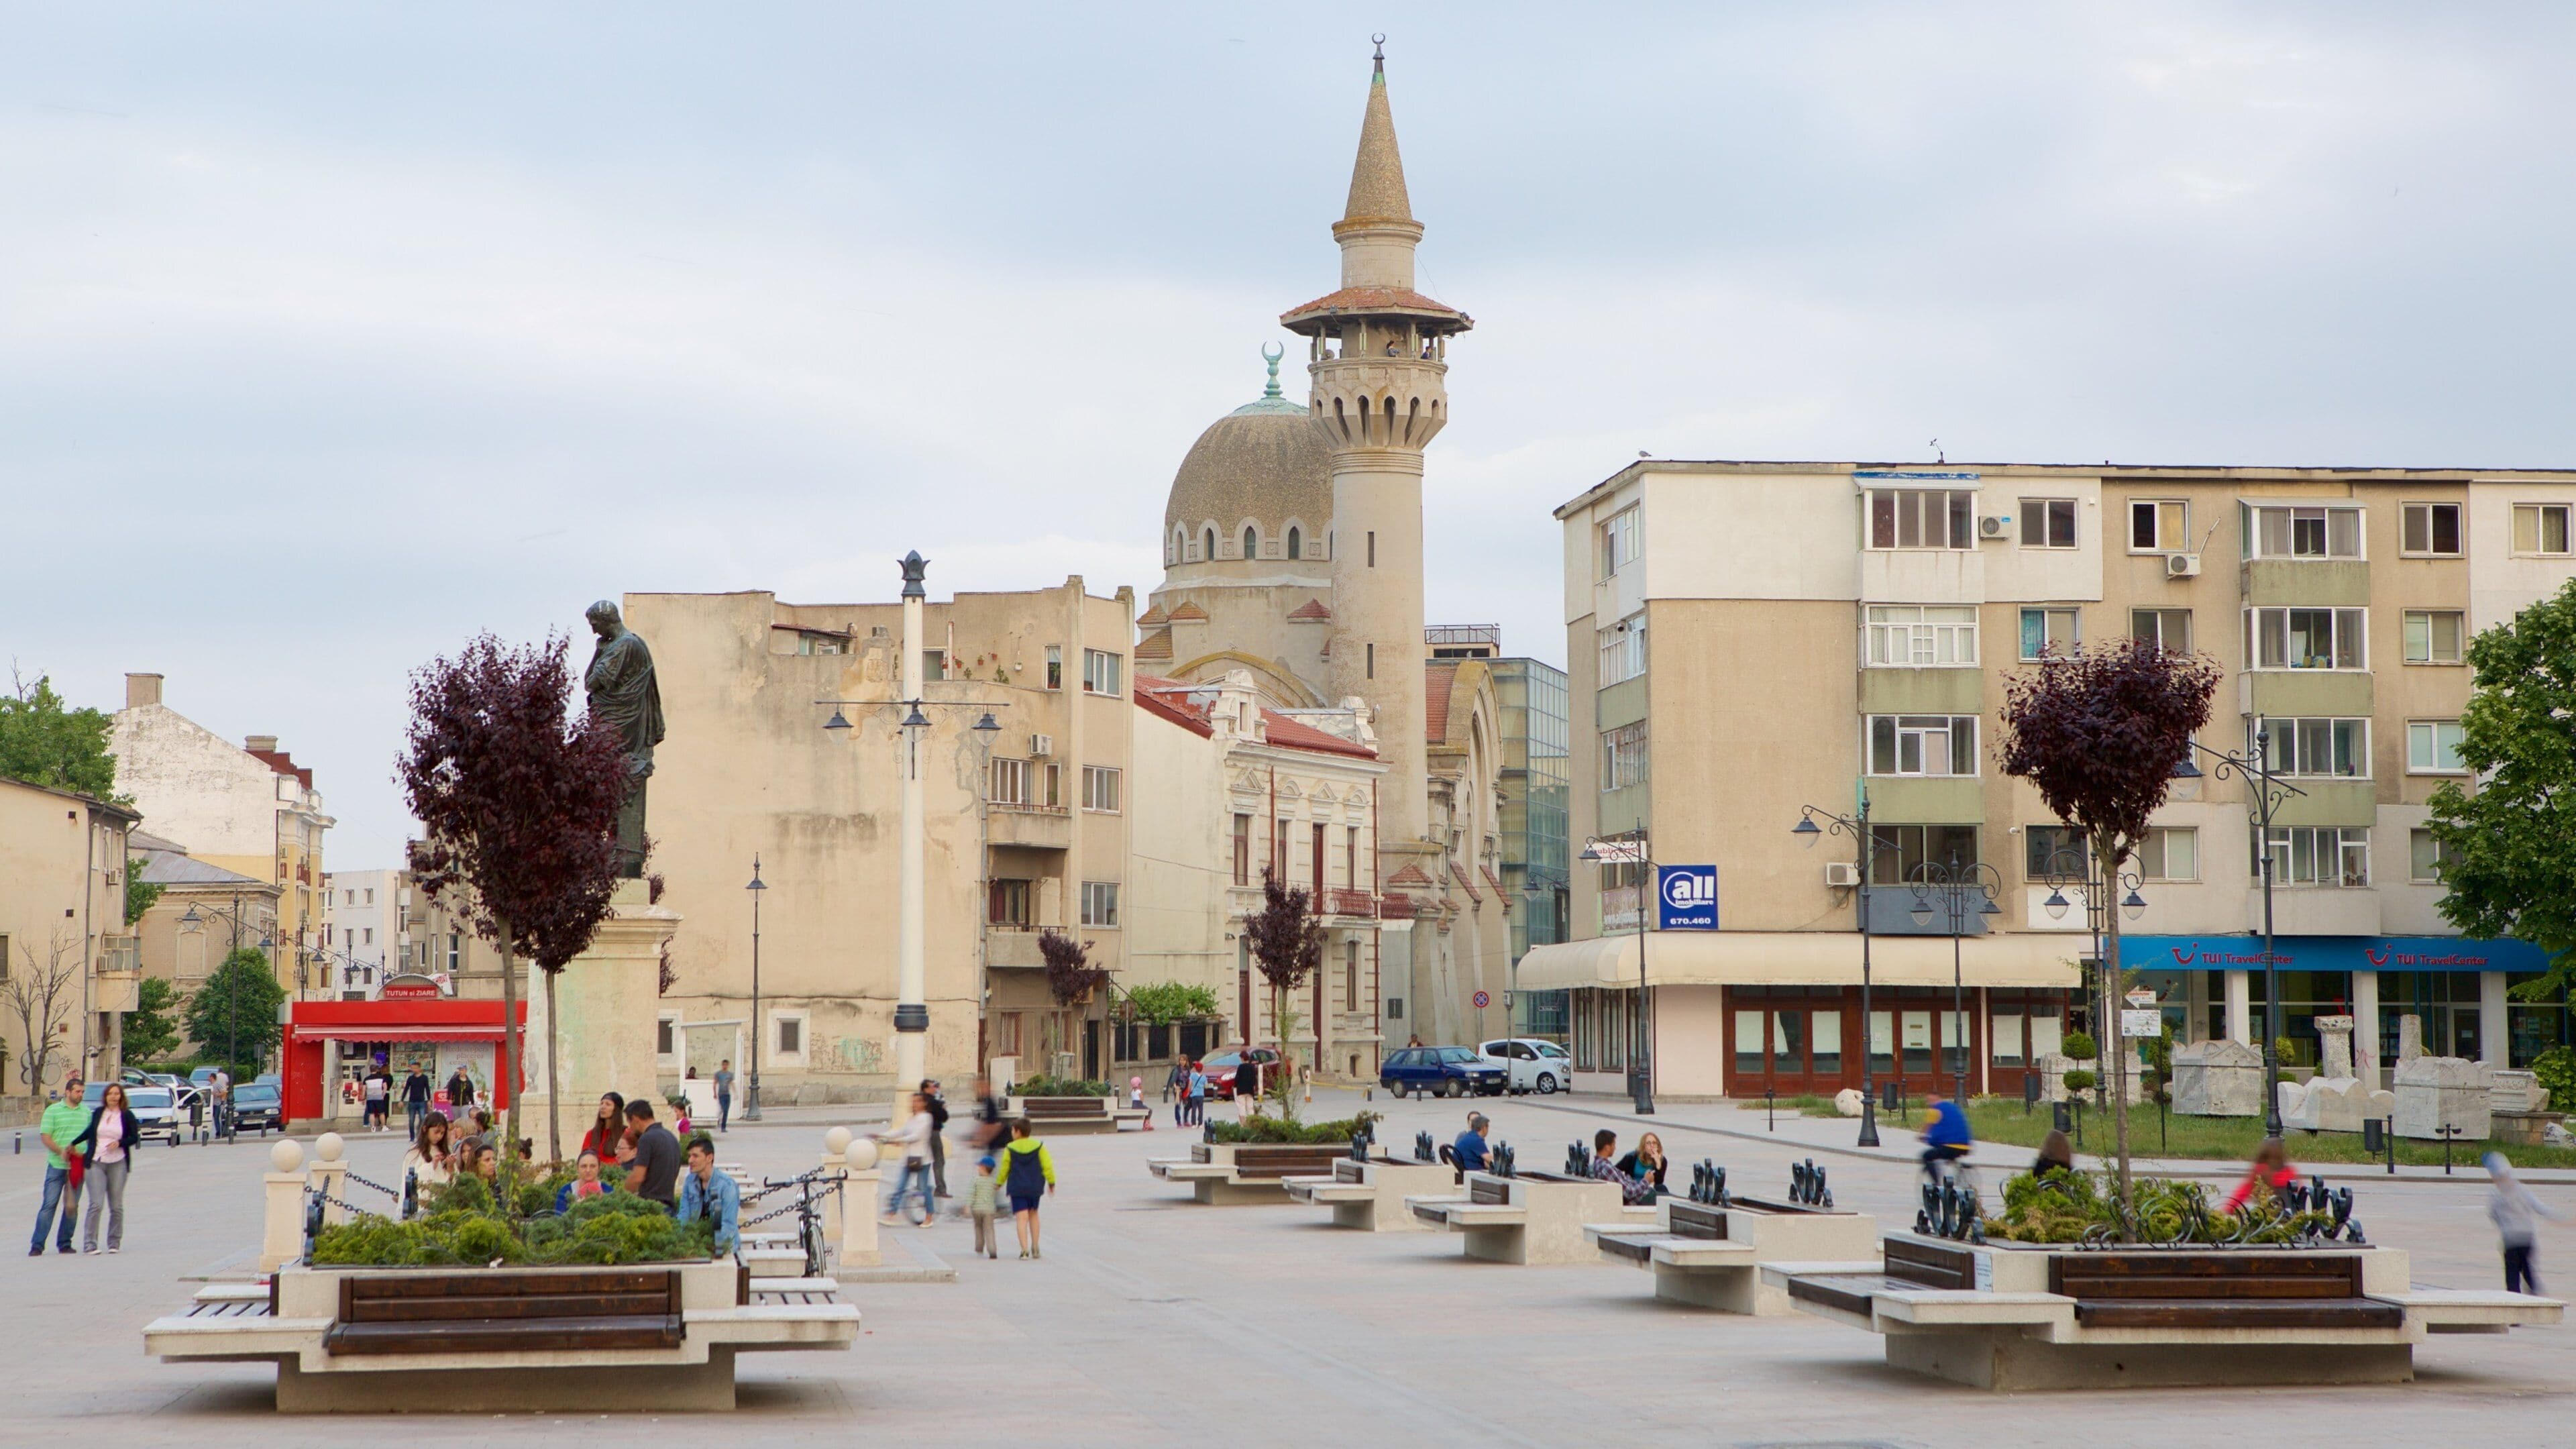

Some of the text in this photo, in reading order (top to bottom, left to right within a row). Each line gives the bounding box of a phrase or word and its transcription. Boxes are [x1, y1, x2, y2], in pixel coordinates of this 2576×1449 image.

[2202, 953, 2294, 964] TUI TravelCnter
[2397, 955, 2489, 965] TUI TravelCenter
